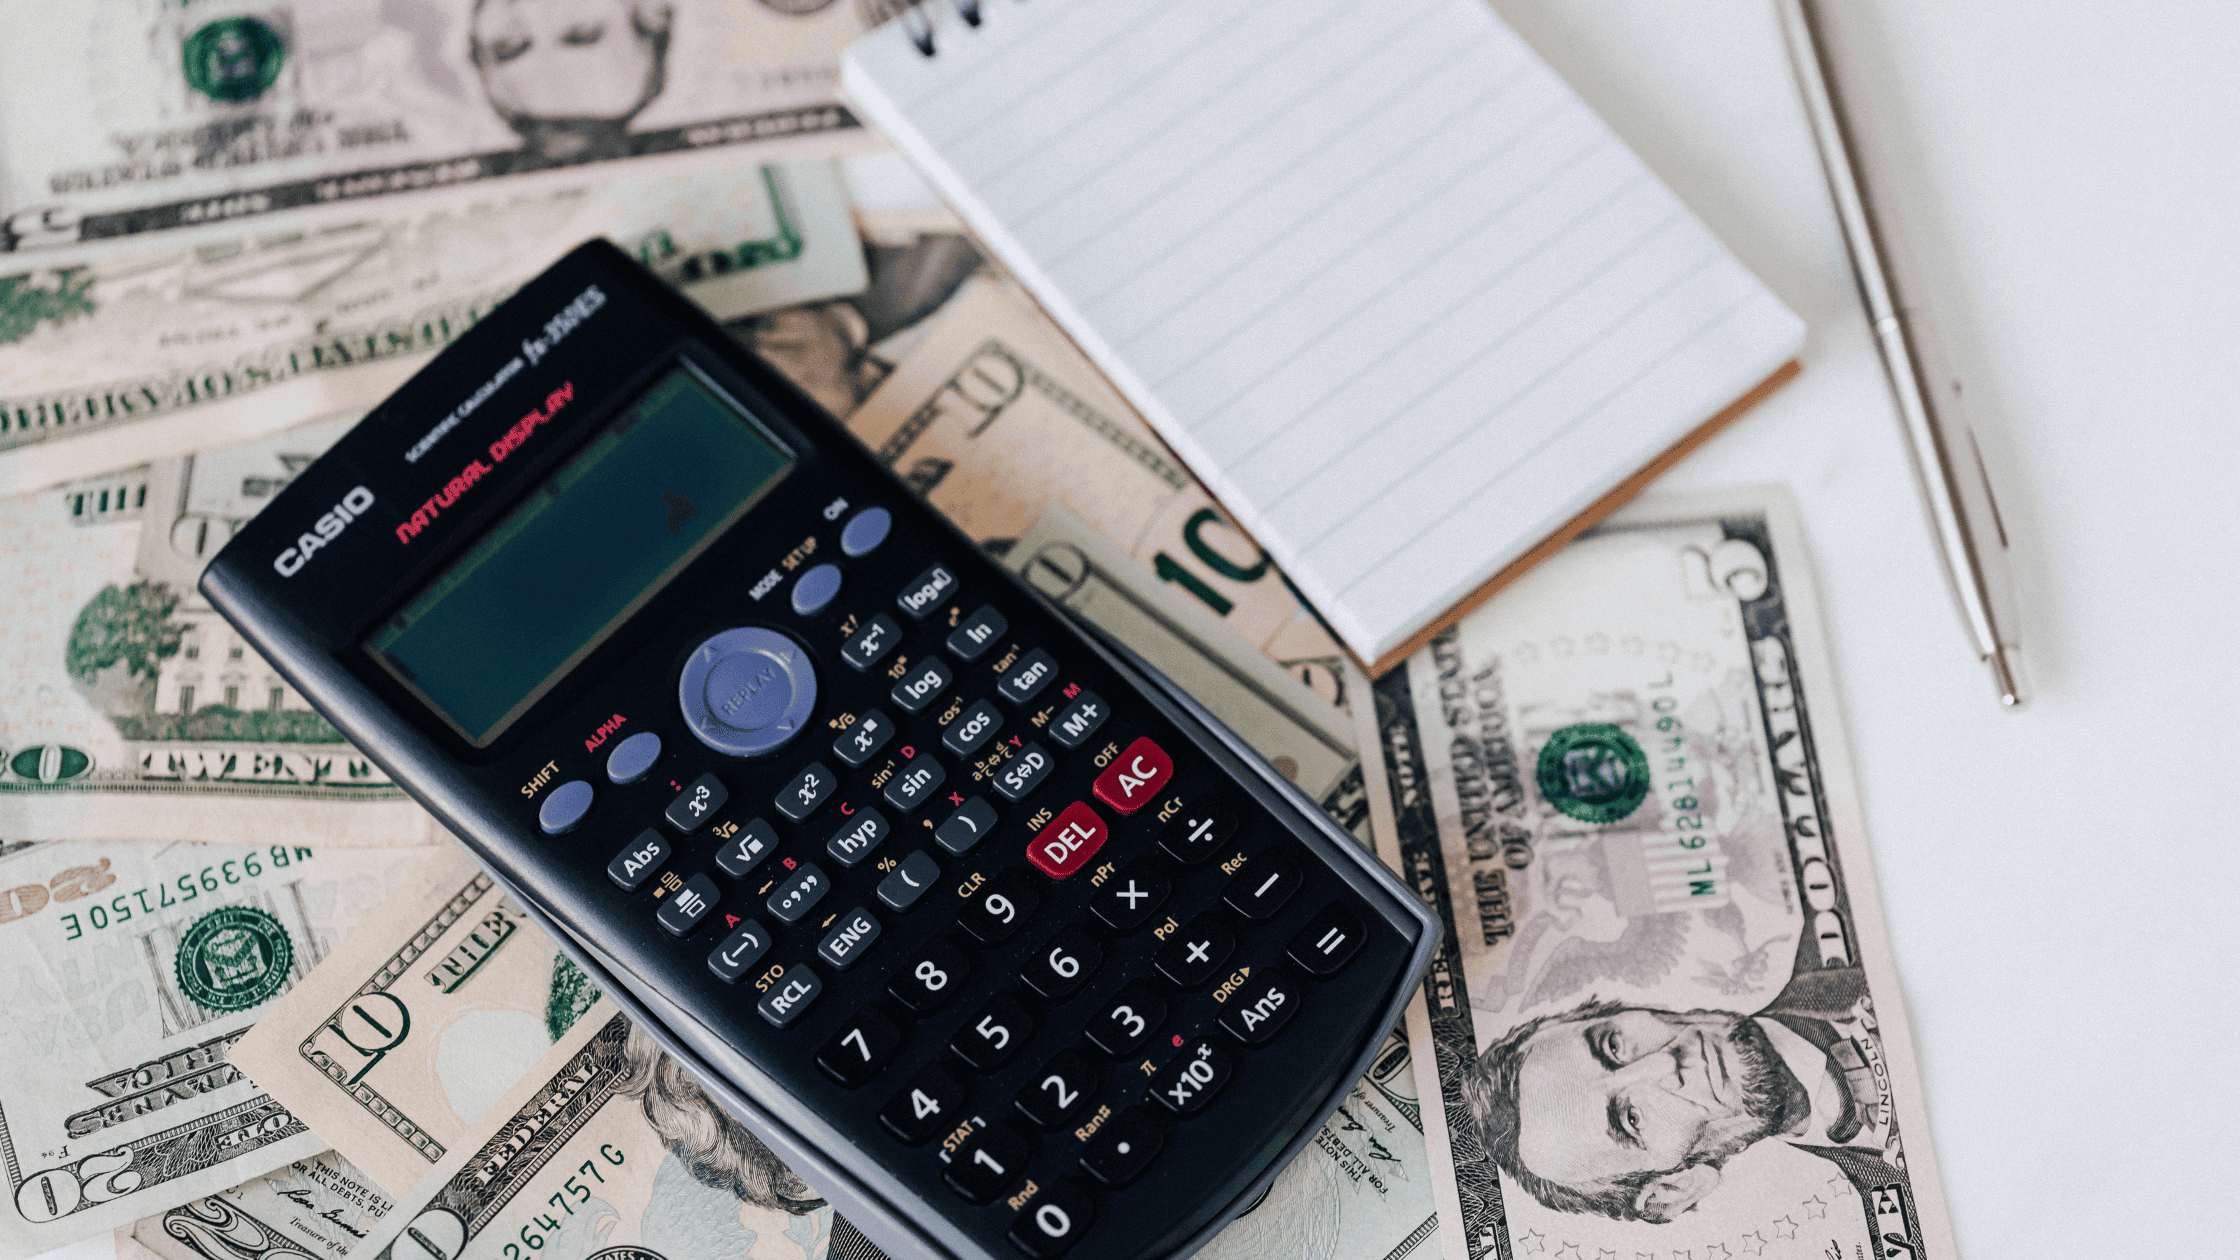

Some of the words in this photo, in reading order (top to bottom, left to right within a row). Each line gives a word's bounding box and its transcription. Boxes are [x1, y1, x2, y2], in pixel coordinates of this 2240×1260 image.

[396, 458, 493, 544] NATURAL
[488, 381, 574, 464] DISPLAY
[823, 497, 849, 522] ON
[274, 486, 375, 577] CASIO
[721, 667, 778, 717] REPLAY
[904, 669, 943, 700] log
[1013, 662, 1049, 690] tan
[584, 712, 628, 754] ALPHA
[959, 712, 991, 742] cos
[1062, 704, 1098, 742] M+
[901, 745, 915, 759] D
[1008, 734, 1023, 748] Y
[1094, 743, 1119, 768] OFF
[521, 759, 560, 799] SHIFT
[901, 769, 932, 797] sin
[1118, 755, 1158, 798] AC
[1157, 797, 1184, 824] nCr
[1750, 634, 1852, 968] DOLLARS
[1027, 807, 1053, 833] INS
[837, 820, 877, 855] hyp
[1043, 821, 1097, 866] DEL
[622, 840, 661, 878] Abs
[1091, 862, 1116, 888] nPr
[1220, 852, 1248, 876] Rec
[89, 851, 263, 930] 93957150
[958, 872, 987, 899] CLR
[1686, 858, 1717, 897] ML
[985, 893, 1015, 924] 9
[60, 913, 84, 941] E
[828, 916, 872, 958] ENG
[1153, 916, 1180, 942] Pol
[1413, 849, 1456, 1011] RERVE
[423, 910, 517, 994] THE
[1049, 947, 1080, 978] 6
[755, 964, 784, 994] STO
[915, 960, 948, 991] 8
[770, 980, 812, 1015] RCL
[1241, 987, 1286, 1033] Ans
[976, 1015, 1009, 1050] 5
[1111, 1005, 1145, 1037] 3
[308, 990, 411, 1087] 10
[841, 1028, 871, 1061] 7
[1041, 1075, 1078, 1109] 2
[1860, 1037, 1890, 1127] LINCOLN
[63, 1061, 248, 1140] TATES
[911, 1089, 940, 1119] 4
[1364, 1100, 1396, 1133] Treasurer
[213, 1110, 294, 1151] OTE
[474, 1053, 603, 1187] FEDERAL
[1075, 1105, 1111, 1141] Ran#
[599, 1143, 626, 1167] G
[974, 1149, 1004, 1174] 1
[1314, 1136, 1342, 1162] NOTE
[1347, 1154, 1370, 1176] ALL
[15, 1146, 143, 1224] 20
[291, 1161, 308, 1175] OR
[308, 1171, 328, 1187] ALL
[313, 1161, 340, 1182] THIS
[340, 1176, 370, 1199] NOTE
[369, 1193, 383, 1207] IS
[1340, 1159, 1364, 1183] THIS
[1368, 1173, 1390, 1195] FOR
[1008, 1180, 1038, 1210] Rnd
[289, 1216, 327, 1244] Treasurer
[326, 1238, 339, 1252] of
[1036, 1205, 1070, 1237] 0
